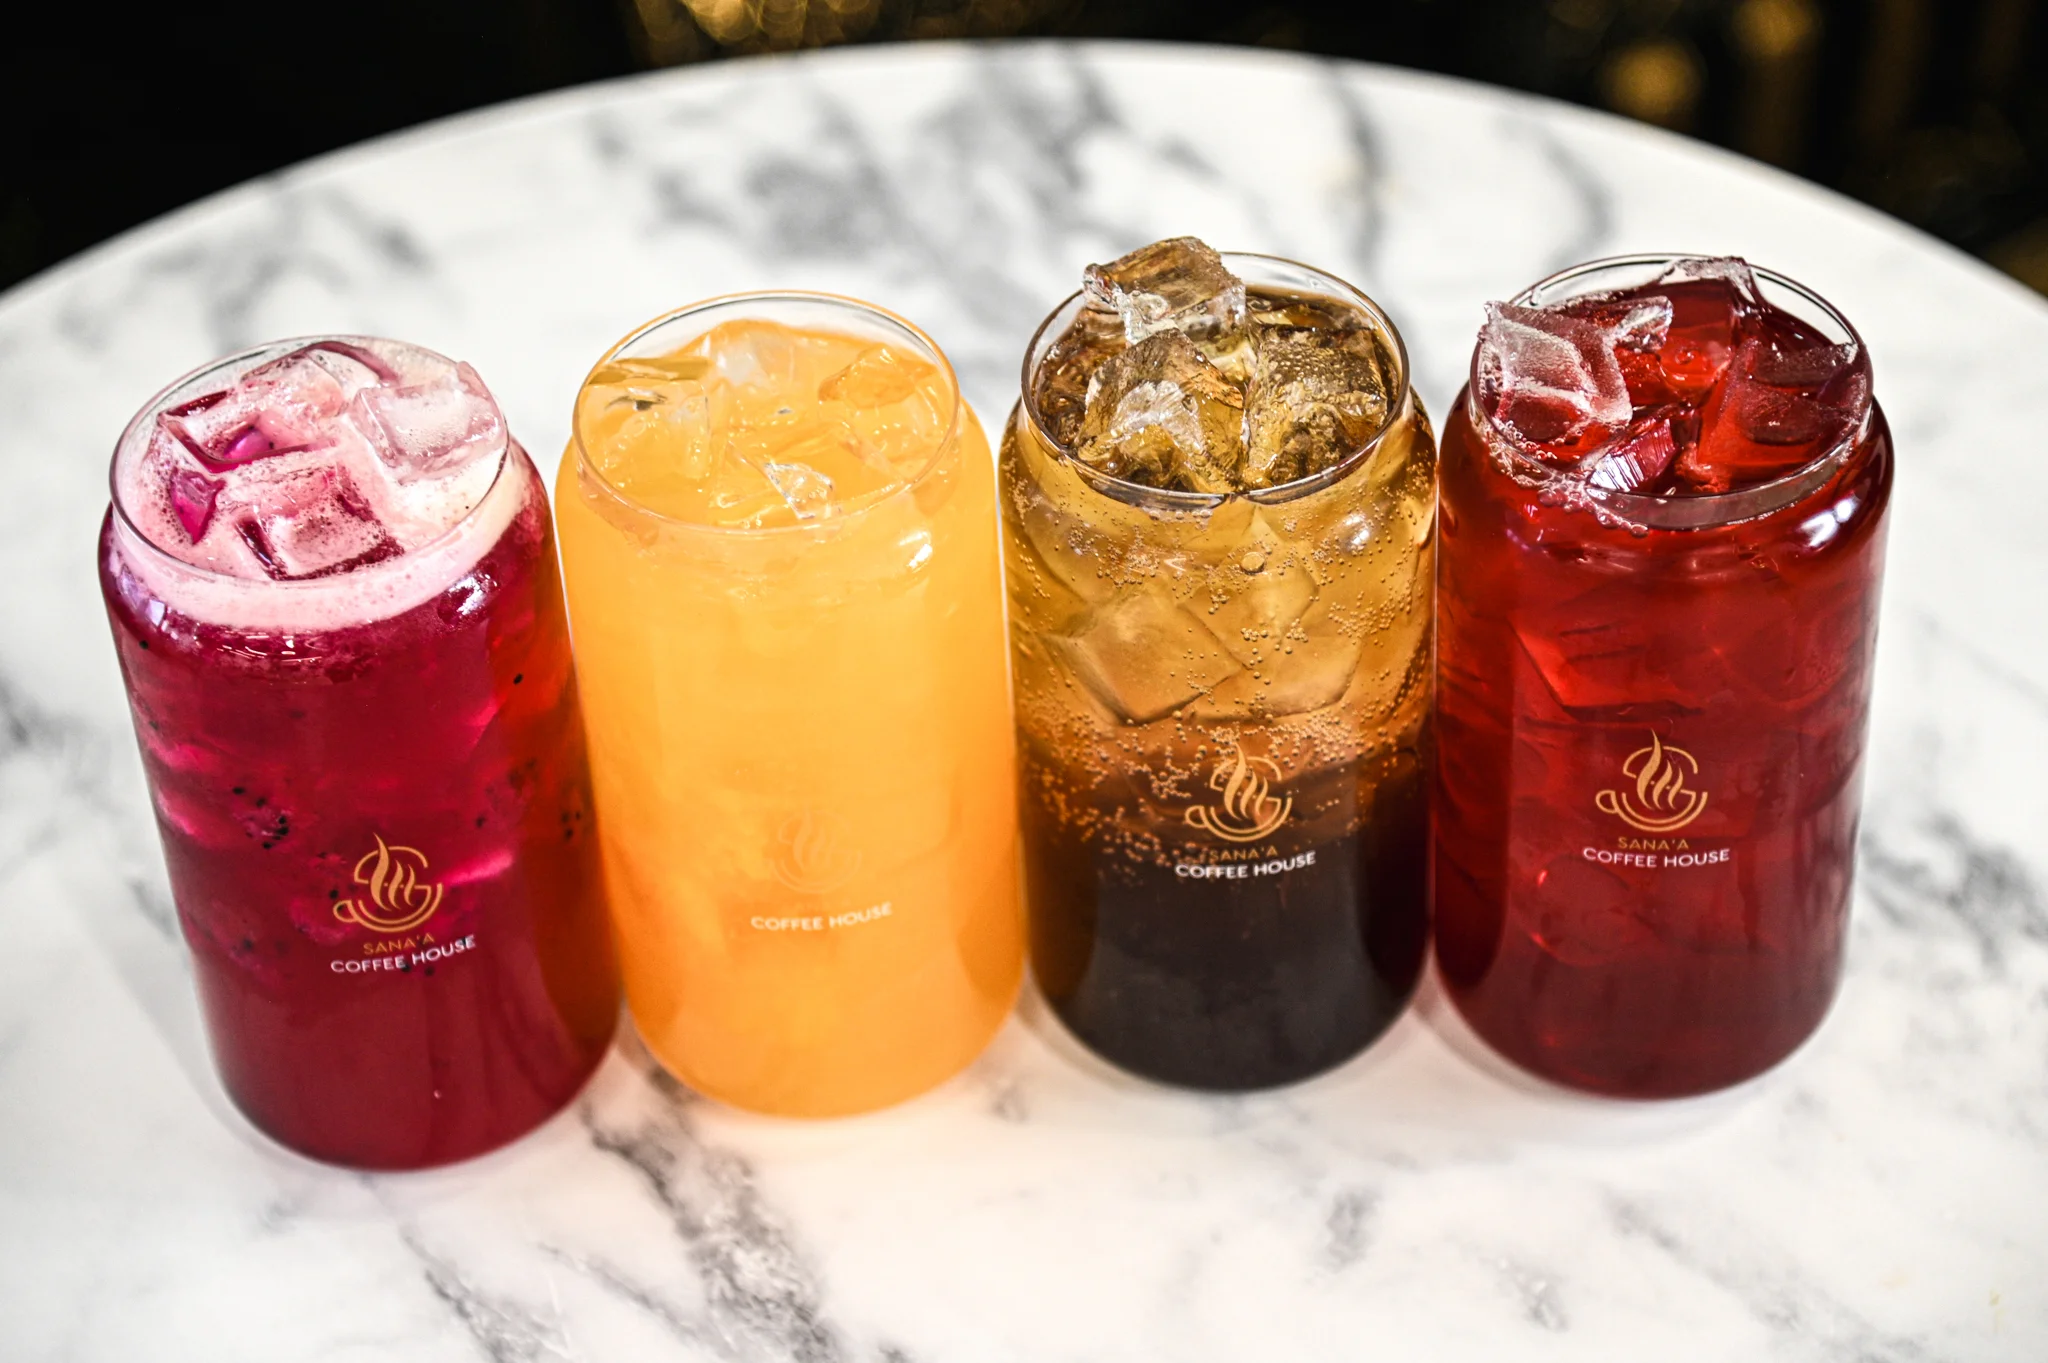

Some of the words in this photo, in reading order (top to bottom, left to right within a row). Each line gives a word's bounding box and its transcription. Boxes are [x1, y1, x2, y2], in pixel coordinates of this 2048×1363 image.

[1209, 845, 1279, 861] SANA'A
[1618, 836, 1689, 851] SANA'A
[1175, 864, 1248, 879] COFFEE
[1253, 850, 1316, 877] HOUSE
[1583, 847, 1657, 868] COFFEE
[1664, 849, 1730, 867] HOUSE
[751, 916, 824, 931] COFFEE
[829, 901, 892, 928] HOUSE
[330, 955, 407, 973] COFFEE
[411, 934, 476, 965] HOUSE
[363, 932, 435, 955] SANA'A
